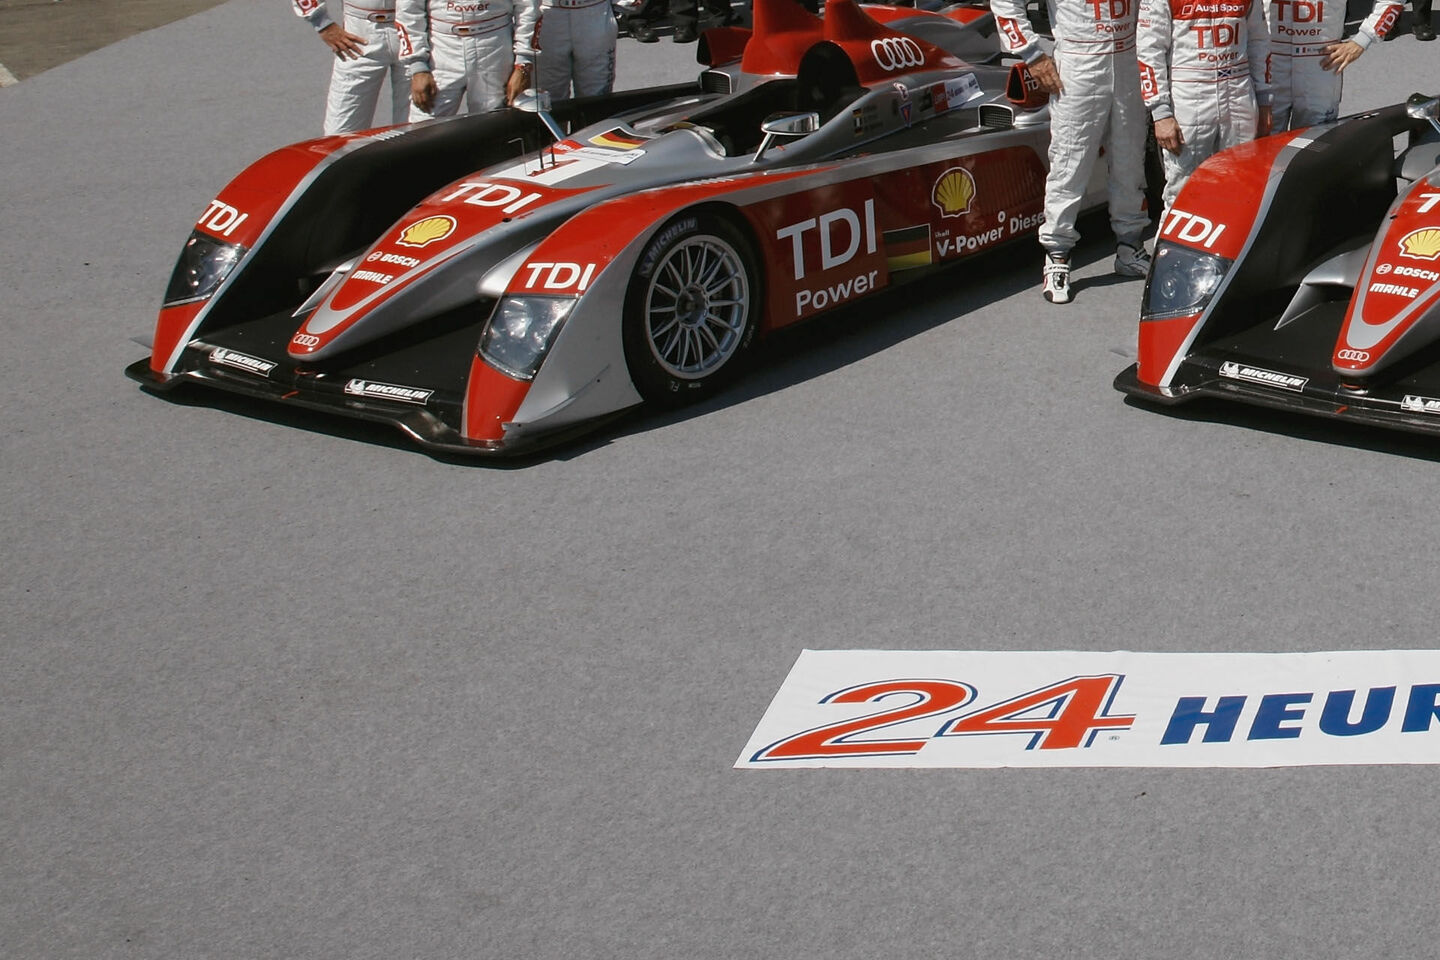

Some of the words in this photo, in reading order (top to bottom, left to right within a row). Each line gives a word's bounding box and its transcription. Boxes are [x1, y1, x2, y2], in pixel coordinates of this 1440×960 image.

[446, 2, 490, 13] Power
[1195, 4, 1218, 12] Audi
[1271, 0, 1324, 23] TDI
[1096, 23, 1131, 33] Power
[1278, 25, 1321, 36] Power
[1377, 8, 1400, 34] TDI
[1002, 22, 1023, 49] TDI
[1190, 23, 1239, 49] TDI
[1199, 52, 1239, 62] Power
[1027, 80, 1038, 90] TD
[1140, 67, 1154, 98] TDI
[442, 183, 542, 214] TDI
[199, 200, 248, 236] TDI
[1162, 209, 1226, 248] TDI
[777, 198, 878, 281] TDI
[937, 226, 1004, 257] V-Power
[1010, 212, 1046, 234] Diese
[380, 253, 420, 268] BOSCH
[351, 270, 394, 285] MAHLE
[525, 262, 596, 291] TDI
[1393, 266, 1440, 281] BOSCH
[796, 268, 878, 317] Power
[1369, 282, 1419, 298] MAHLE
[225, 353, 273, 371] MICHELIN
[1240, 367, 1304, 386] MICHELIN
[365, 383, 429, 399] MICHELIN
[749, 673, 1137, 762] 24
